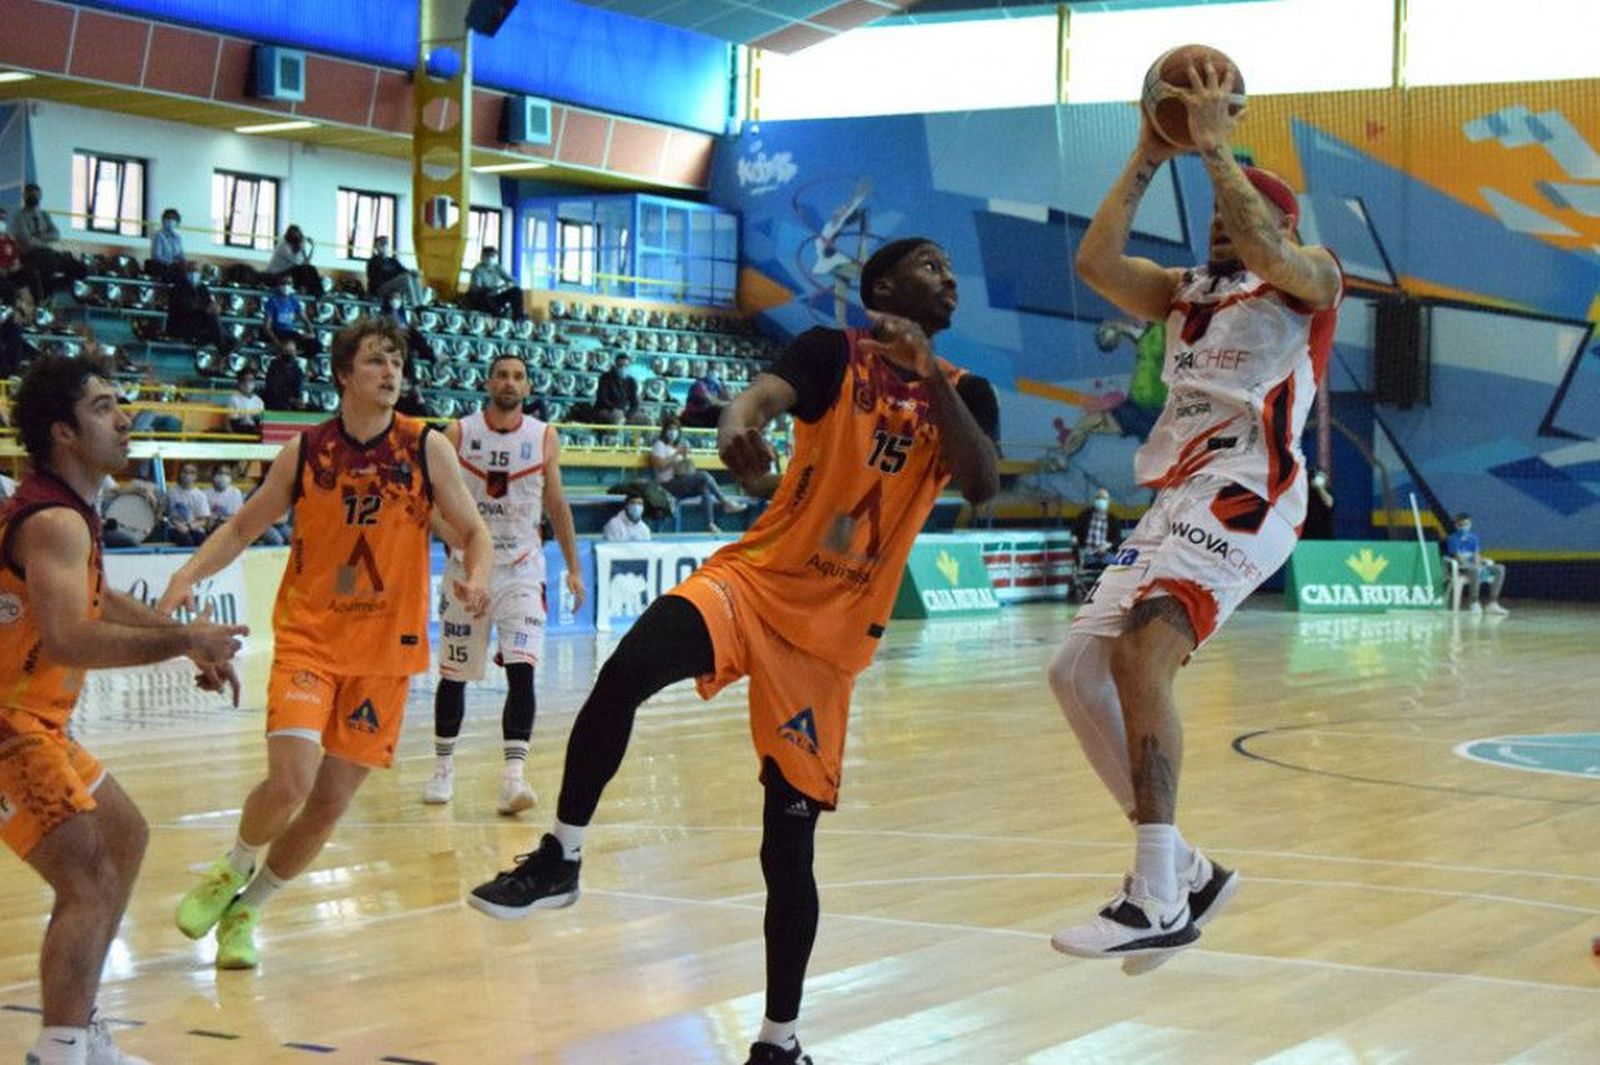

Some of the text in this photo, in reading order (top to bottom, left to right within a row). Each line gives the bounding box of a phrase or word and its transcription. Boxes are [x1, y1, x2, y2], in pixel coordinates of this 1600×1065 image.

[488, 450, 510, 467] 15
[865, 430, 914, 474] 15
[343, 494, 383, 527] 12
[1301, 584, 1444, 605] CAJA RURAL
[448, 643, 469, 663] 15
